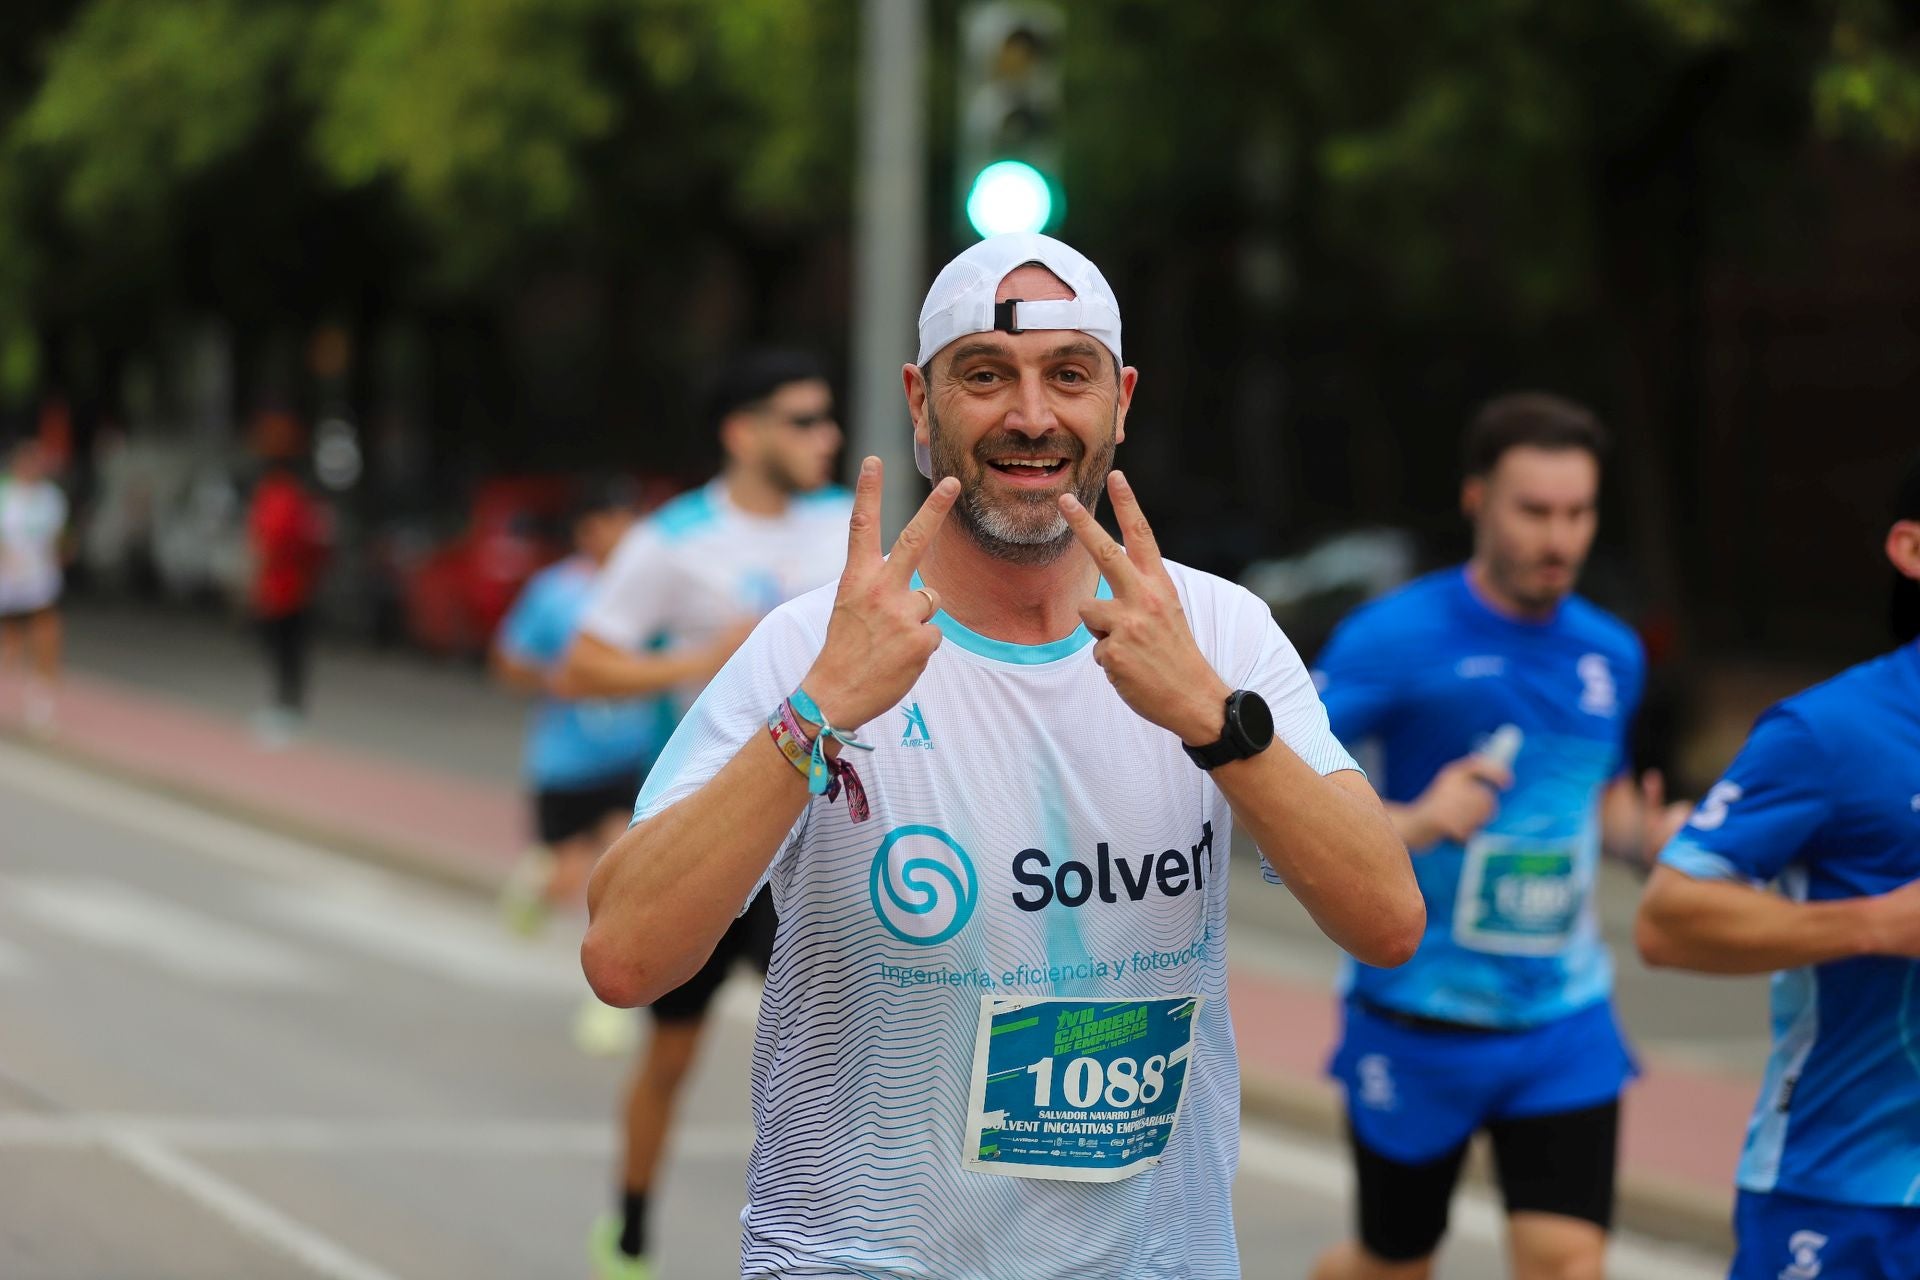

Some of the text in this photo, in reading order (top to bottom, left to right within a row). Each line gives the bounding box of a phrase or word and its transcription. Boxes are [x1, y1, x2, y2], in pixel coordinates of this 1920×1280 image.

[1002, 957, 1108, 986] eficiencia
[1113, 959, 1126, 981] y
[1054, 1041, 1073, 1056] DE
[1074, 1019, 1148, 1050] EMPRESAS
[1055, 1005, 1148, 1045] CARRERA
[1027, 1054, 1166, 1108] 1088
[986, 1119, 1041, 1132] OLVENT
[1043, 1121, 1114, 1135] INICIATIVAS
[1038, 1110, 1088, 1120] SALVADOR
[1089, 1110, 1130, 1120] NAVARRO
